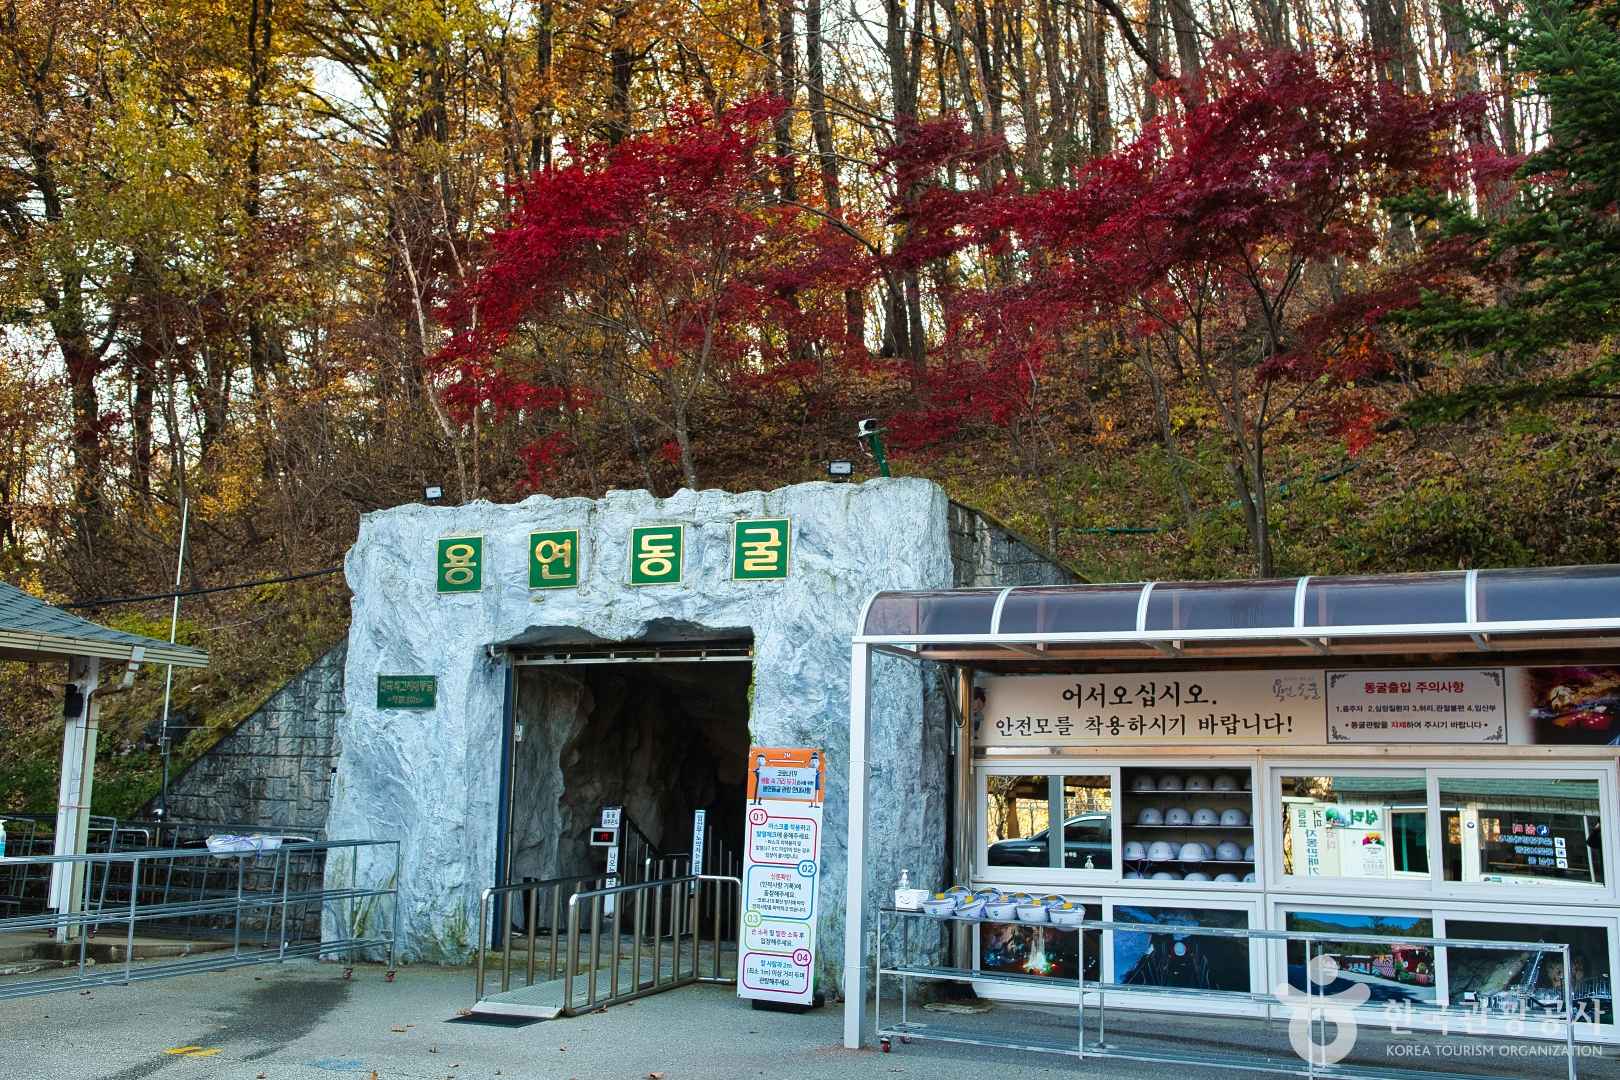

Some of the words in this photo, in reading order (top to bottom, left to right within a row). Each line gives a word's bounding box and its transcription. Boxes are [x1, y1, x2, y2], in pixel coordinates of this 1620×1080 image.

[1364, 681, 1412, 694] 동굴출입
[1415, 681, 1464, 694] 주의사항
[1061, 681, 1217, 709] 어서오십시오.
[995, 715, 1075, 737] 안전모를
[1084, 713, 1186, 737] 착용하시기
[1198, 712, 1293, 736] 바랍니다!
[1424, 721, 1448, 729] 주시기
[1450, 721, 1482, 729] 바랍니다
[753, 812, 764, 821] 01
[801, 864, 814, 873] 02
[747, 914, 759, 923] 03
[796, 953, 809, 962] 04
